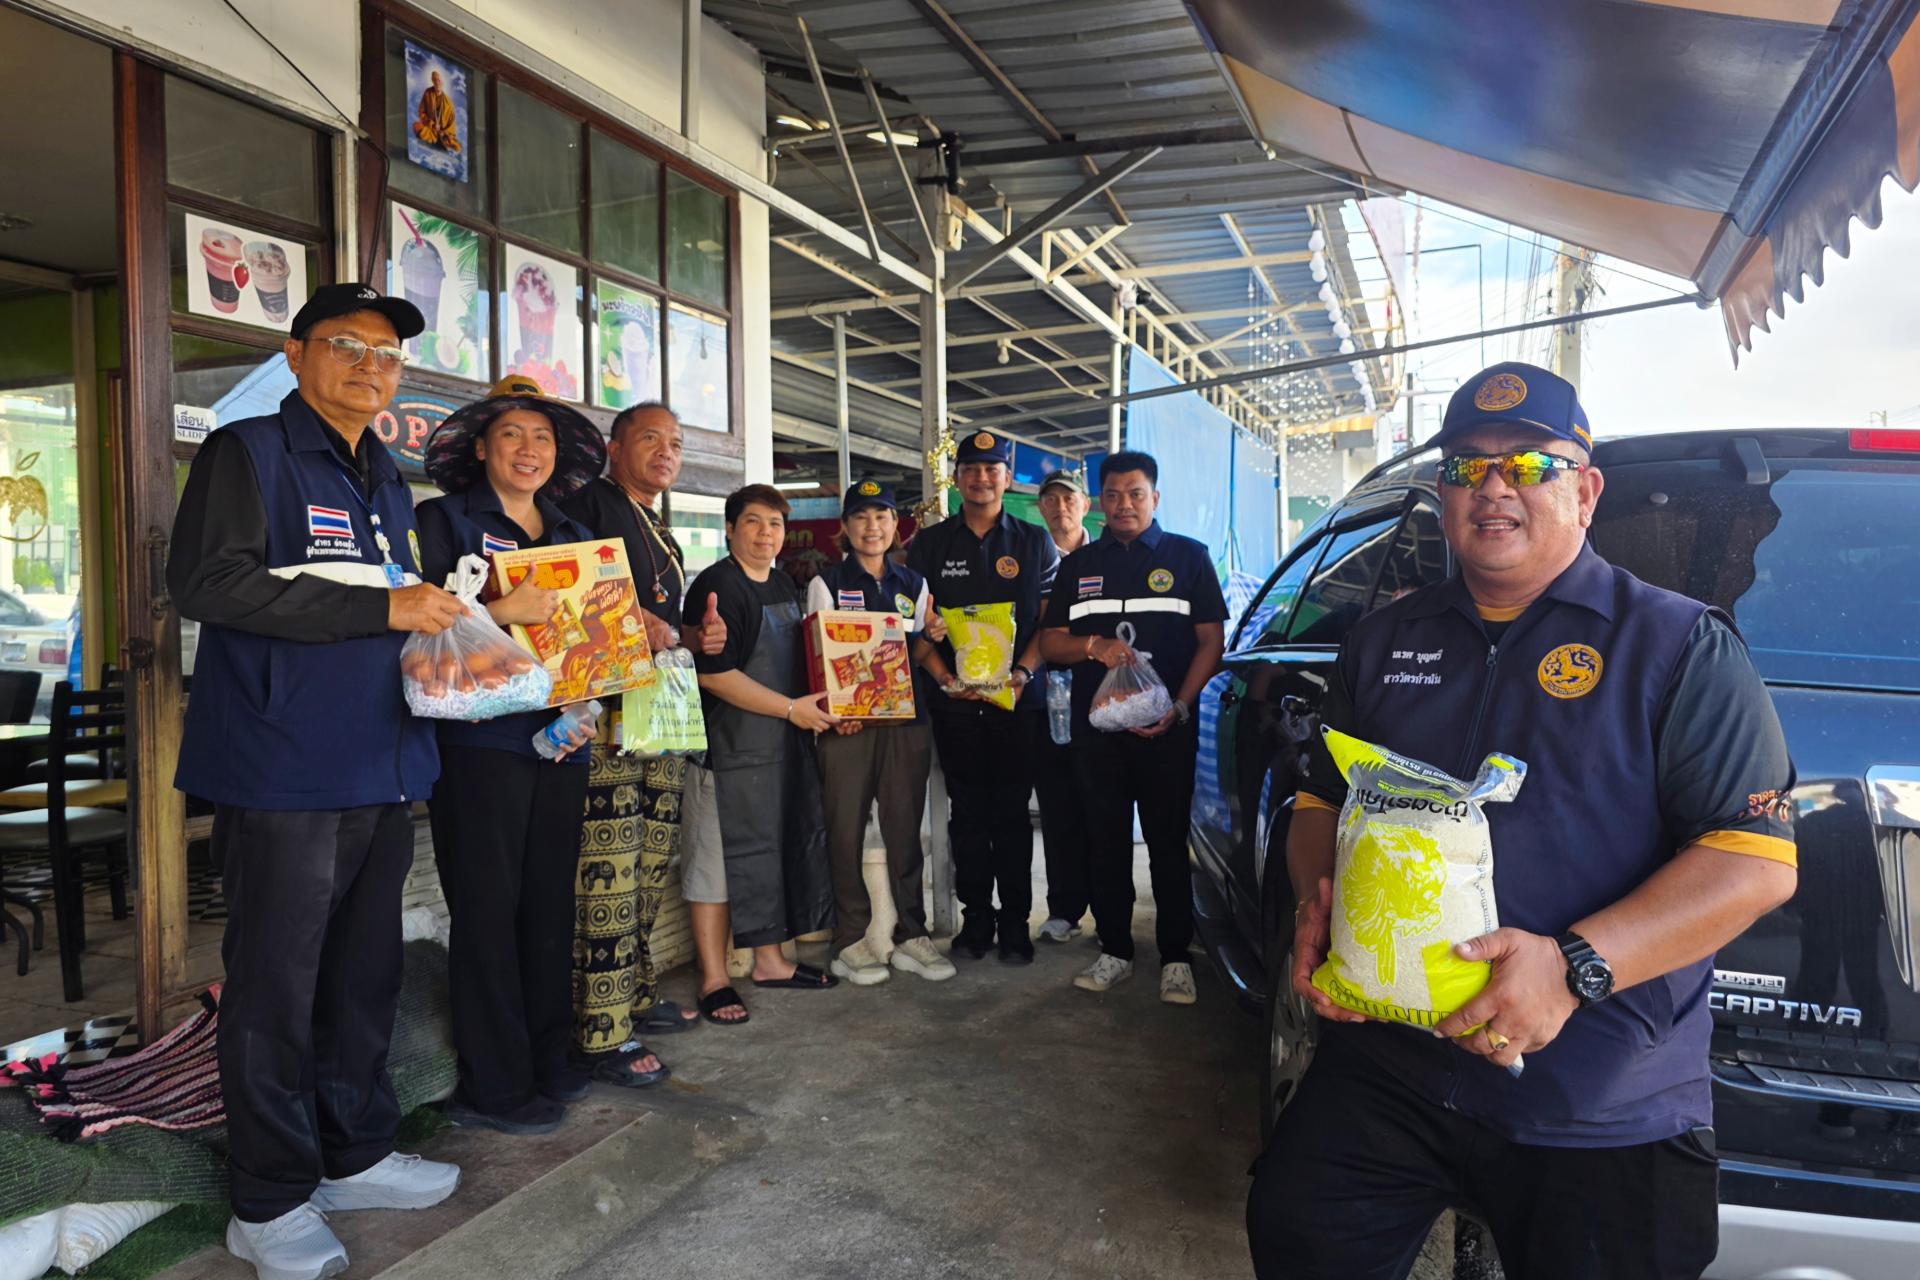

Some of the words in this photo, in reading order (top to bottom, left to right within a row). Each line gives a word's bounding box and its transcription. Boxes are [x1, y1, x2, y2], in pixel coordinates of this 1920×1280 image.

[176, 410, 204, 427] เลื่อน
[176, 429, 206, 440] SLIDE
[374, 410, 443, 448] OP
[1416, 648, 1443, 664] บุญศรี
[1384, 671, 1442, 684] สารวัตรกำนัน
[1707, 991, 1862, 1027] CAPTIVA
